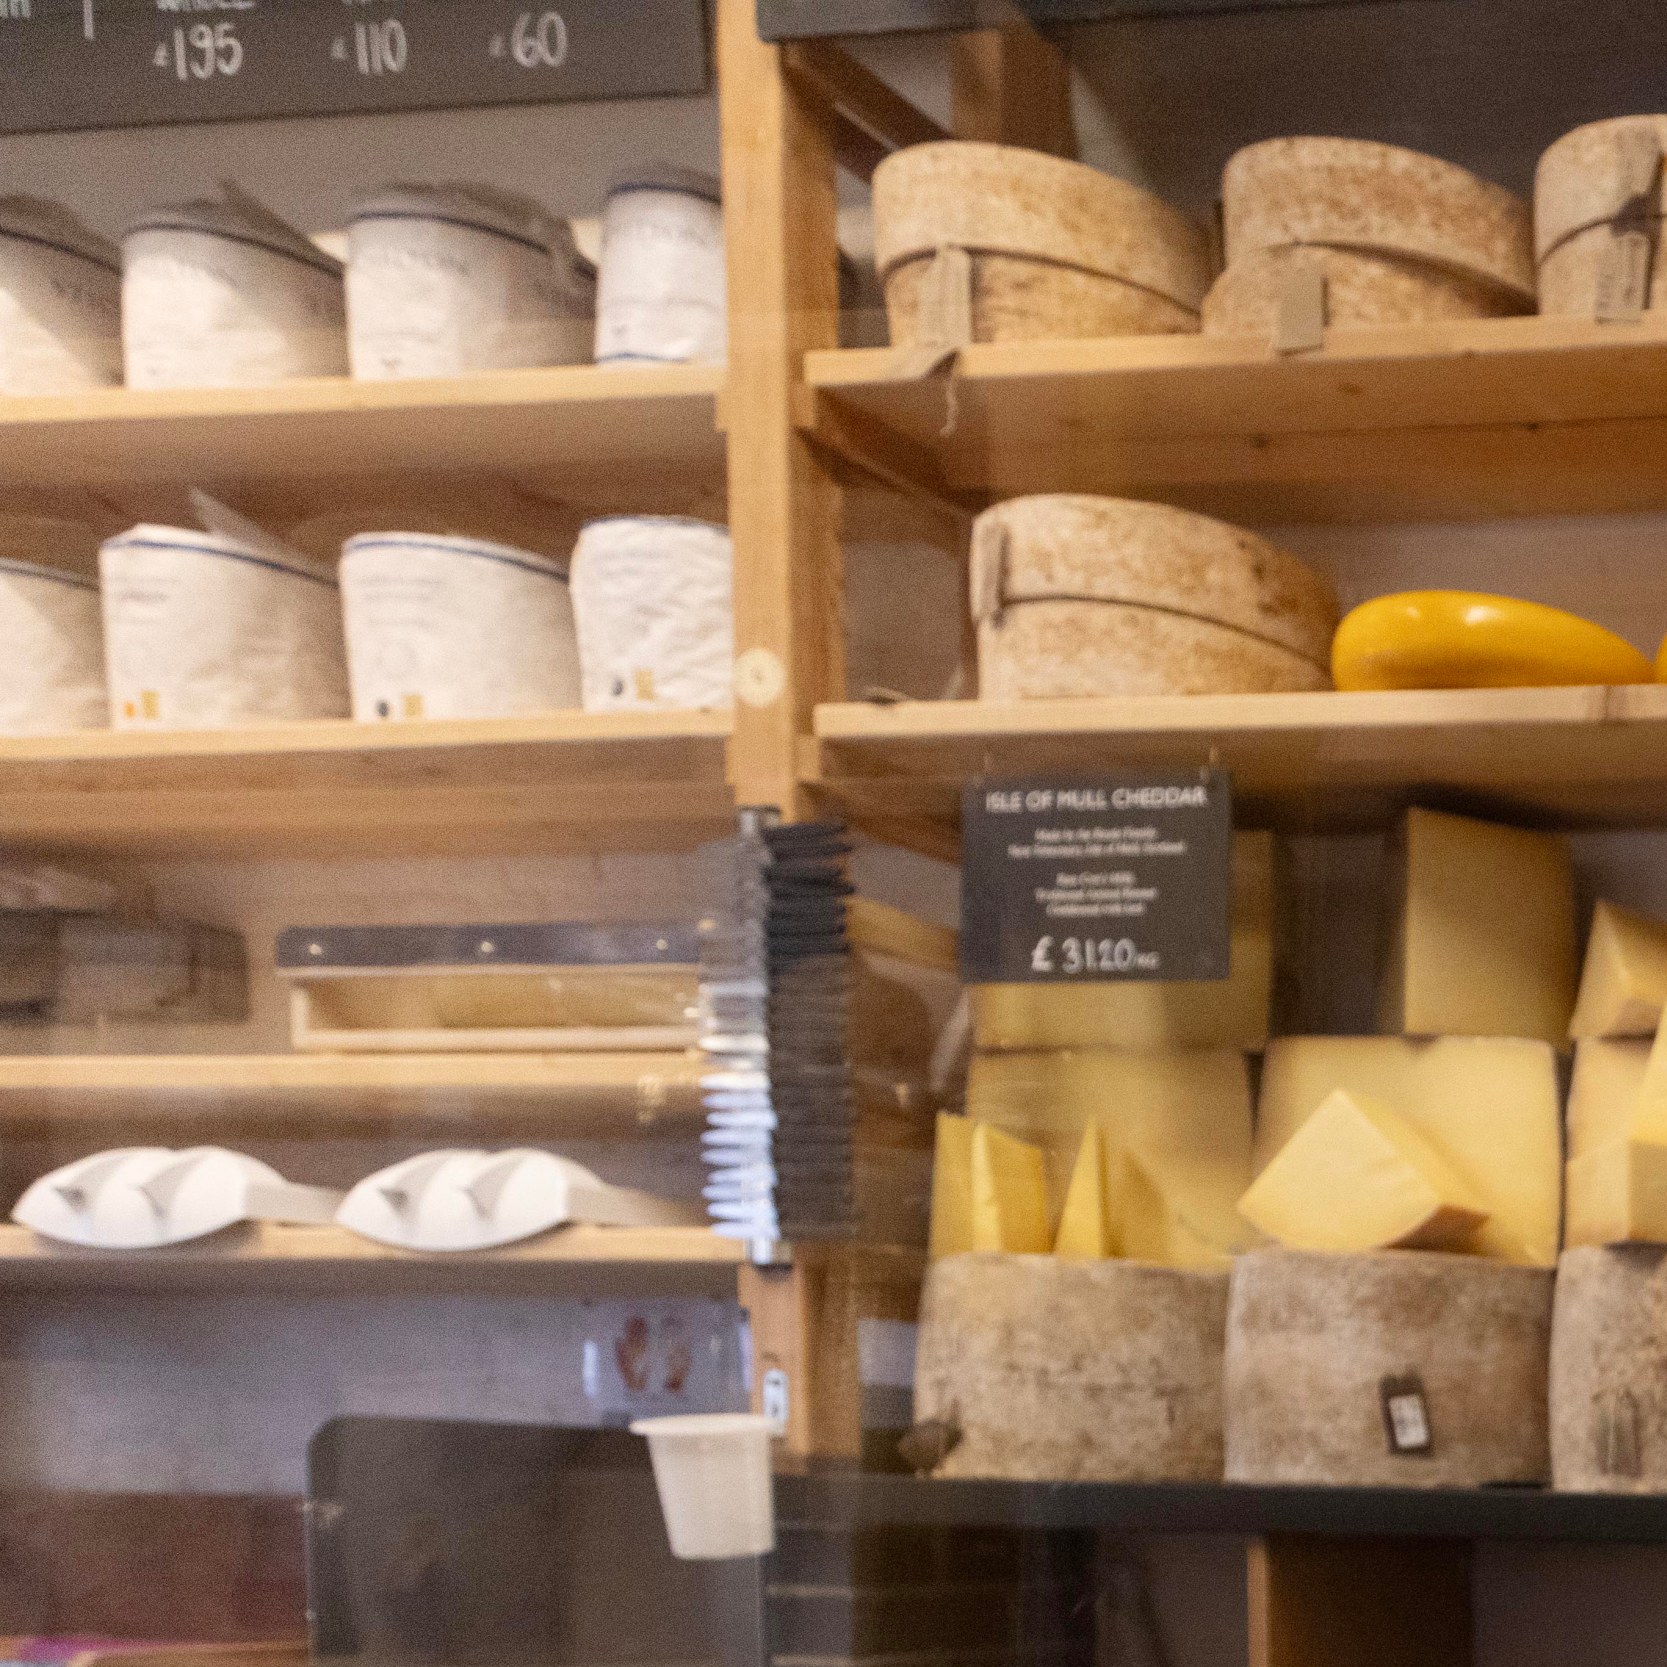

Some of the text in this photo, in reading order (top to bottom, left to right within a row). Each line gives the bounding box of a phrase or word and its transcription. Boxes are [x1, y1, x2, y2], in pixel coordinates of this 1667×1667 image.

[985, 785, 1210, 814] ISLE OF MULL CHEDDAR
